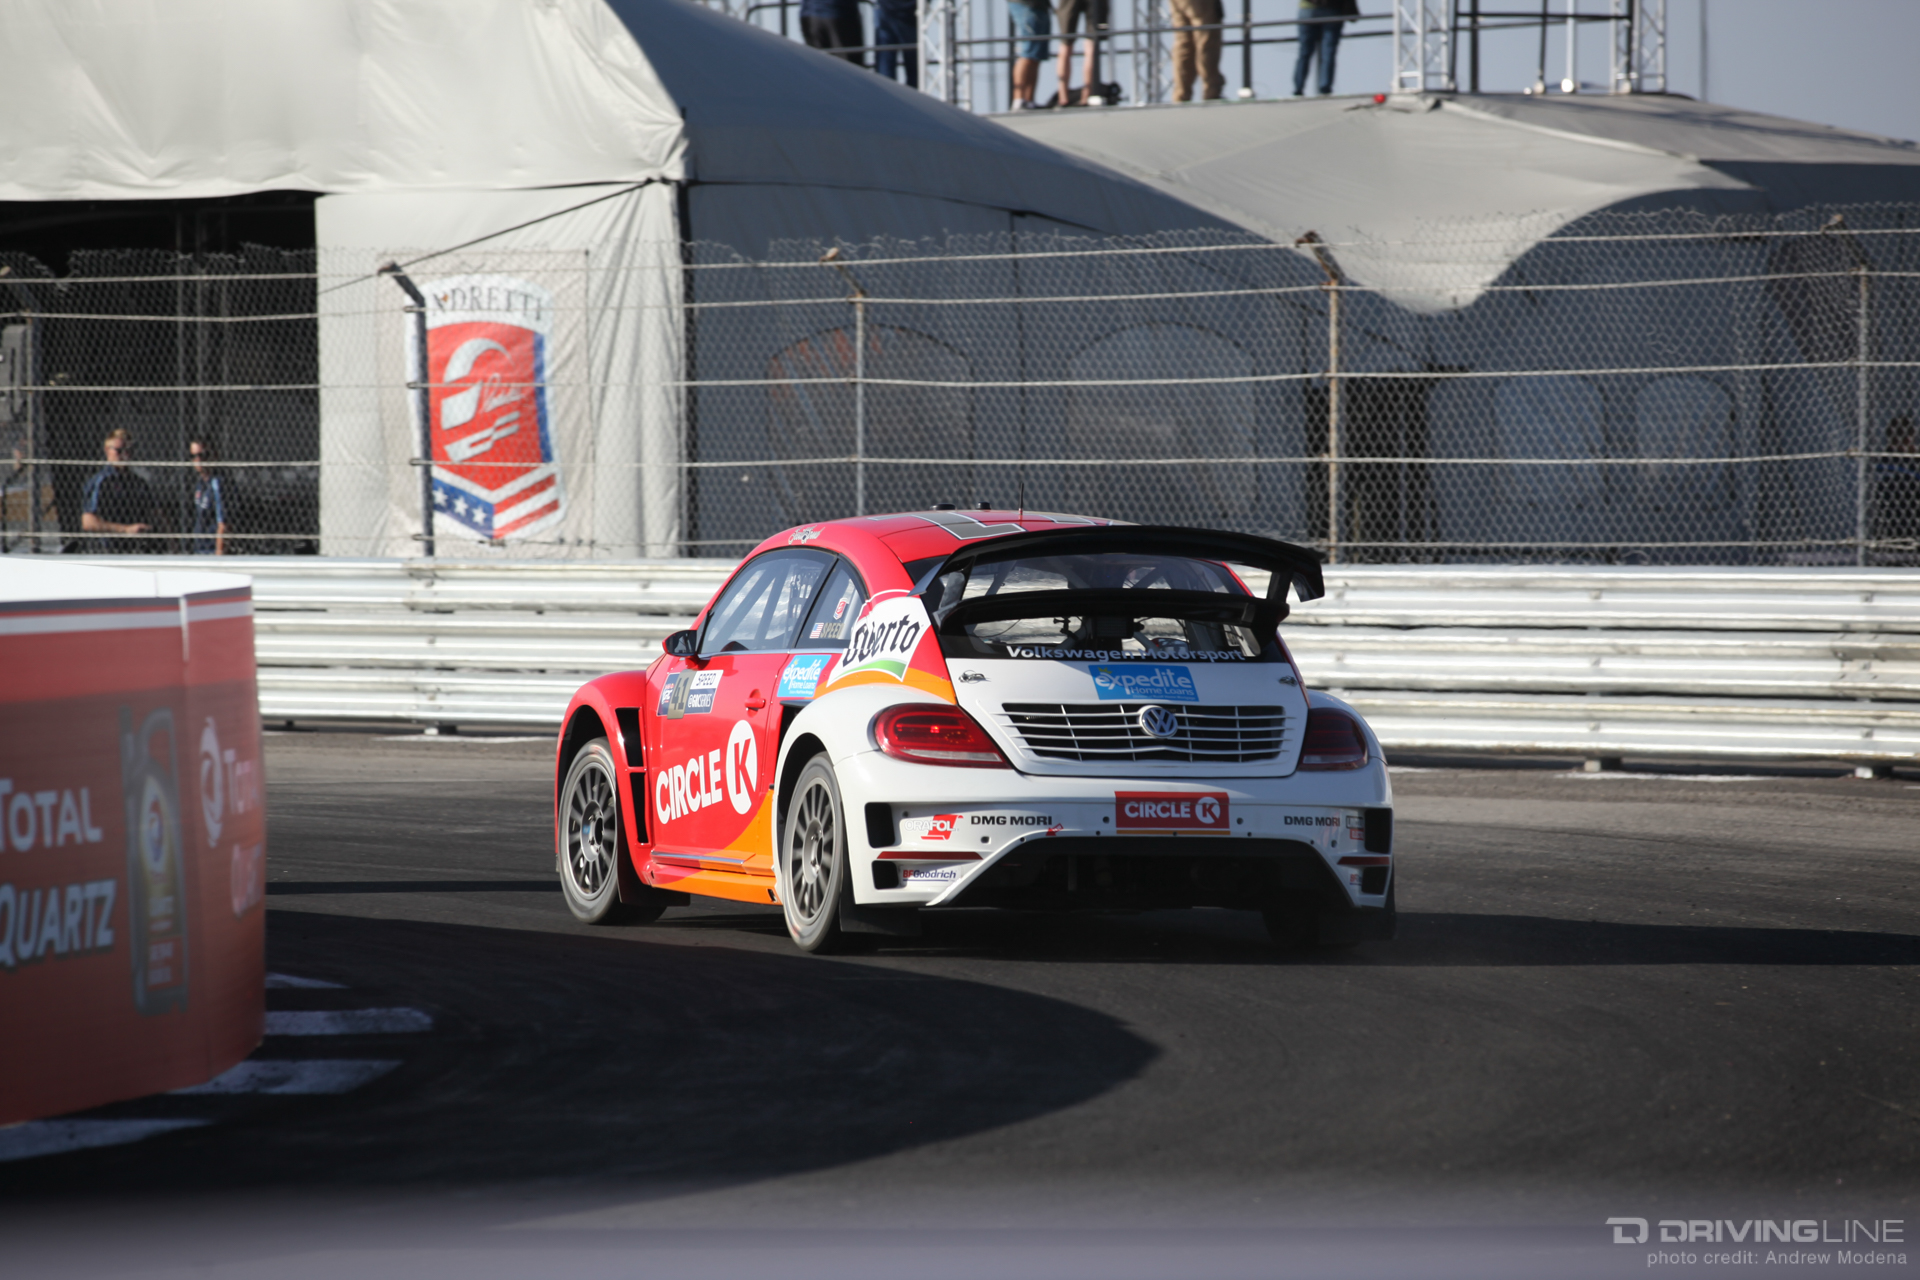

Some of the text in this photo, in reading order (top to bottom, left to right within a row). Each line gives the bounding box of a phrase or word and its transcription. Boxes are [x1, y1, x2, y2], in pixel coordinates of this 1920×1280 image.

[820, 622, 845, 639] SPEED
[1005, 645, 1246, 663] Volkswagen Motorsport
[696, 672, 717, 686] SPEED
[782, 658, 822, 690] expedite
[1094, 667, 1193, 695] expedite
[791, 681, 816, 689] Home Loans
[1130, 686, 1195, 696] Home Loans
[671, 677, 690, 711] 41
[655, 748, 723, 825] CIRCLE
[1123, 801, 1191, 819] CIRCLE
[904, 819, 956, 832] ORAFOL
[970, 815, 1053, 826] DMG MORI
[1283, 815, 1313, 826] DMG
[1315, 816, 1341, 827] MORI
[902, 869, 957, 879] BFGoodrich
[0, 881, 118, 966] QUARTZ
